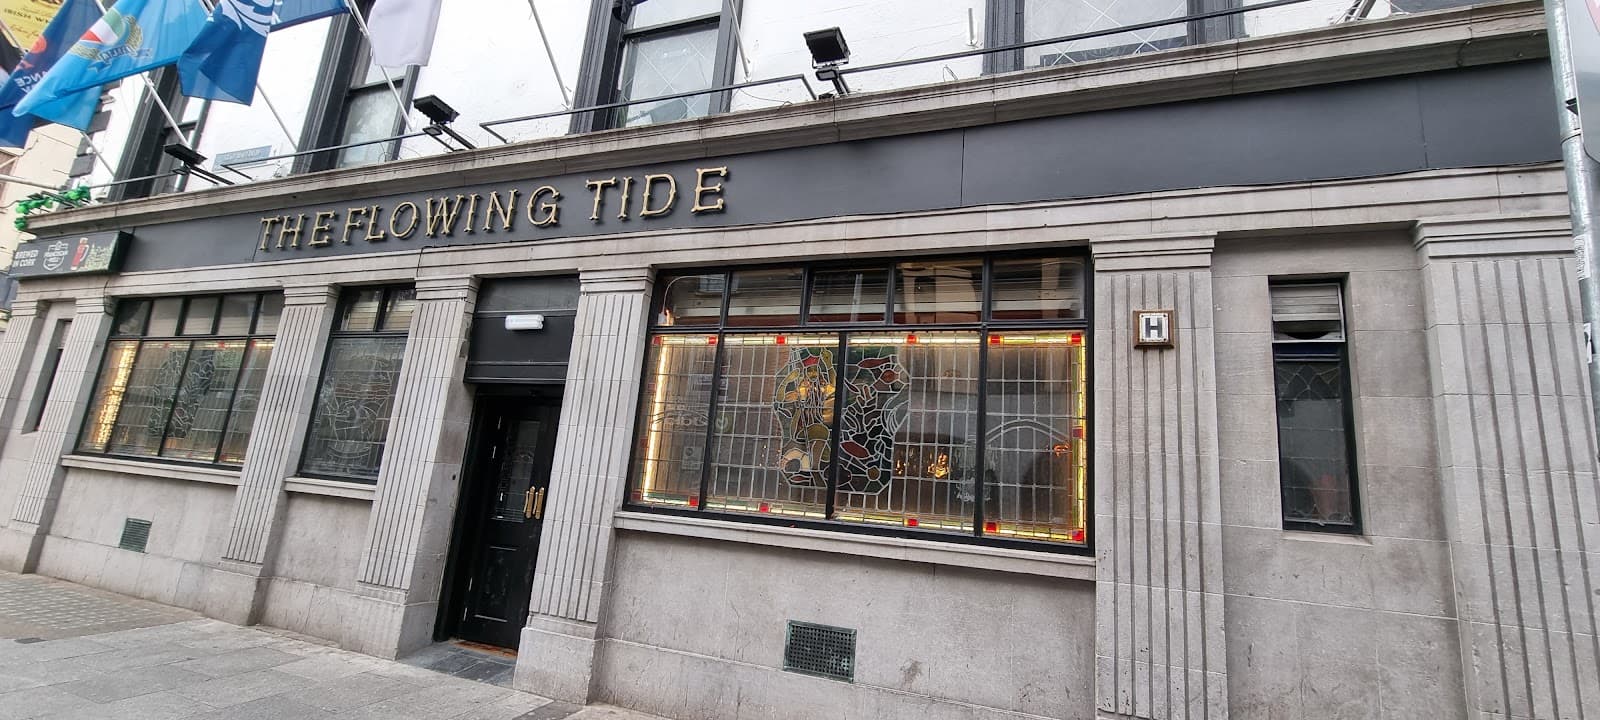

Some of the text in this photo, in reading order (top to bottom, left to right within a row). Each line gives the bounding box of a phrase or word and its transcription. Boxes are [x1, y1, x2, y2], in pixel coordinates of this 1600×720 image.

[258, 165, 729, 251] THE FLOWING TIDE
[1145, 317, 1163, 338] H
